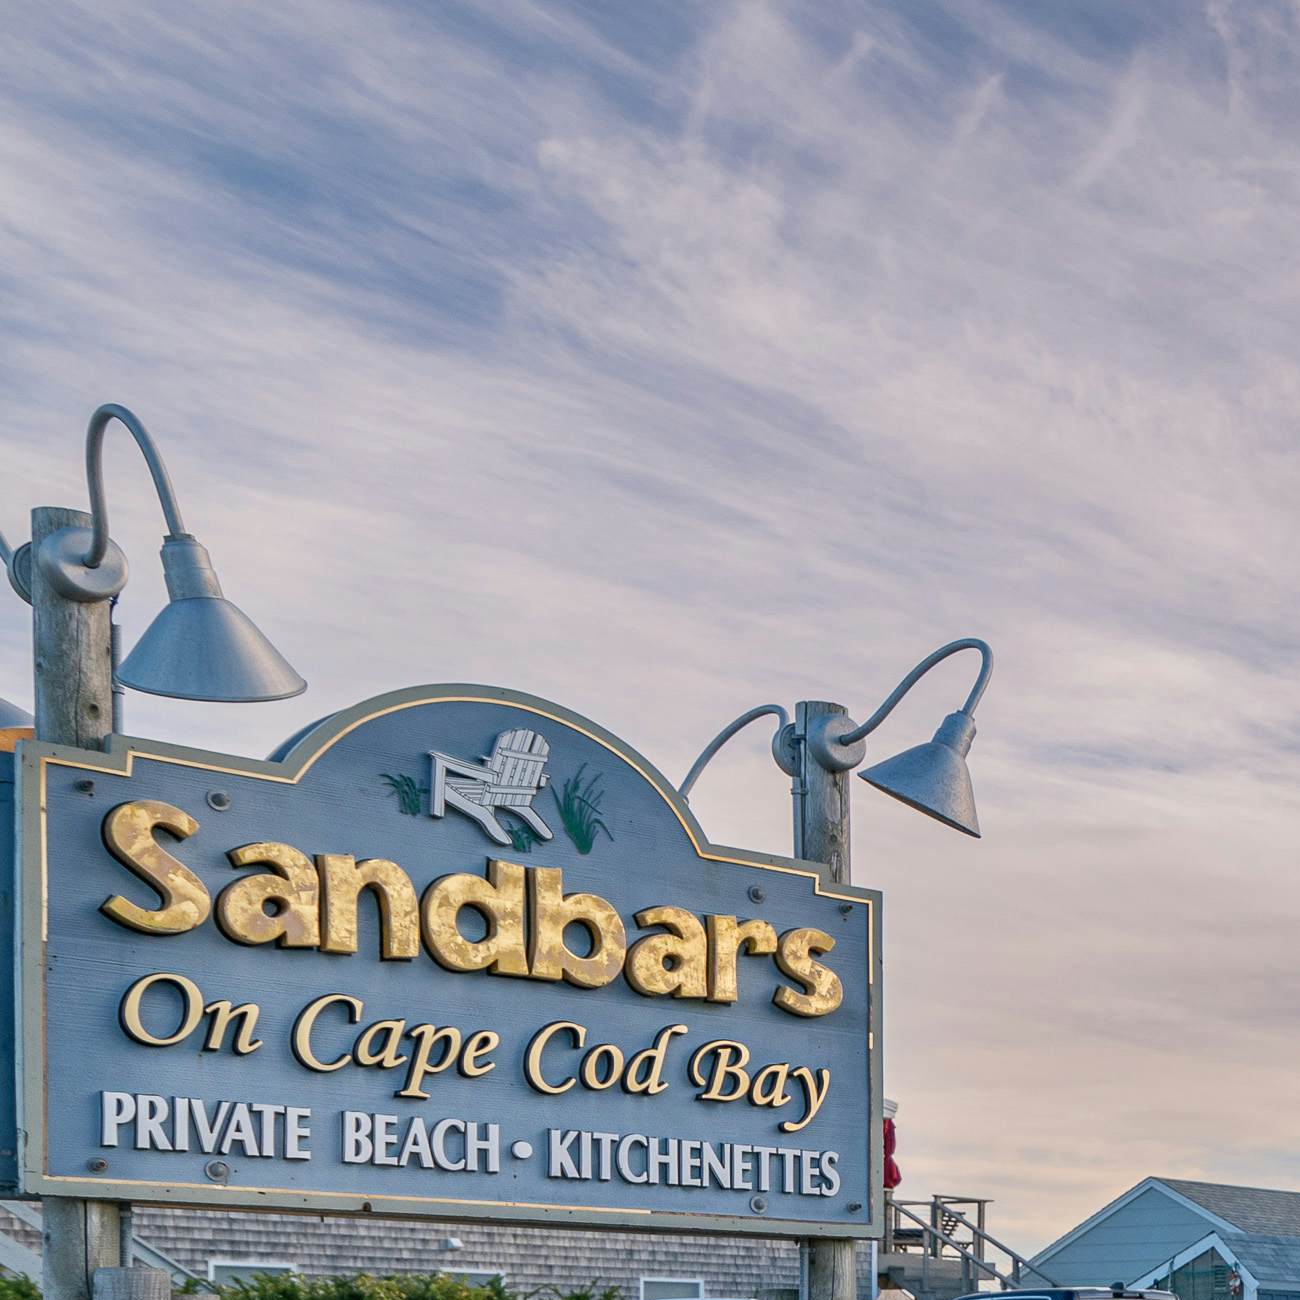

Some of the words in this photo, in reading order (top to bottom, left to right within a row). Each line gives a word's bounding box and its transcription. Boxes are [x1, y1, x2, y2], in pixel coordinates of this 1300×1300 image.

[100, 799, 844, 1017] Sandbars
[118, 972, 263, 1056] On
[290, 993, 500, 1099] Cape
[524, 1020, 688, 1095] Cod
[688, 1039, 830, 1133] Bay
[100, 1090, 312, 1160] PRIVATE
[341, 1110, 500, 1173] BEACH
[547, 1127, 841, 1198] KITCHENETTES
